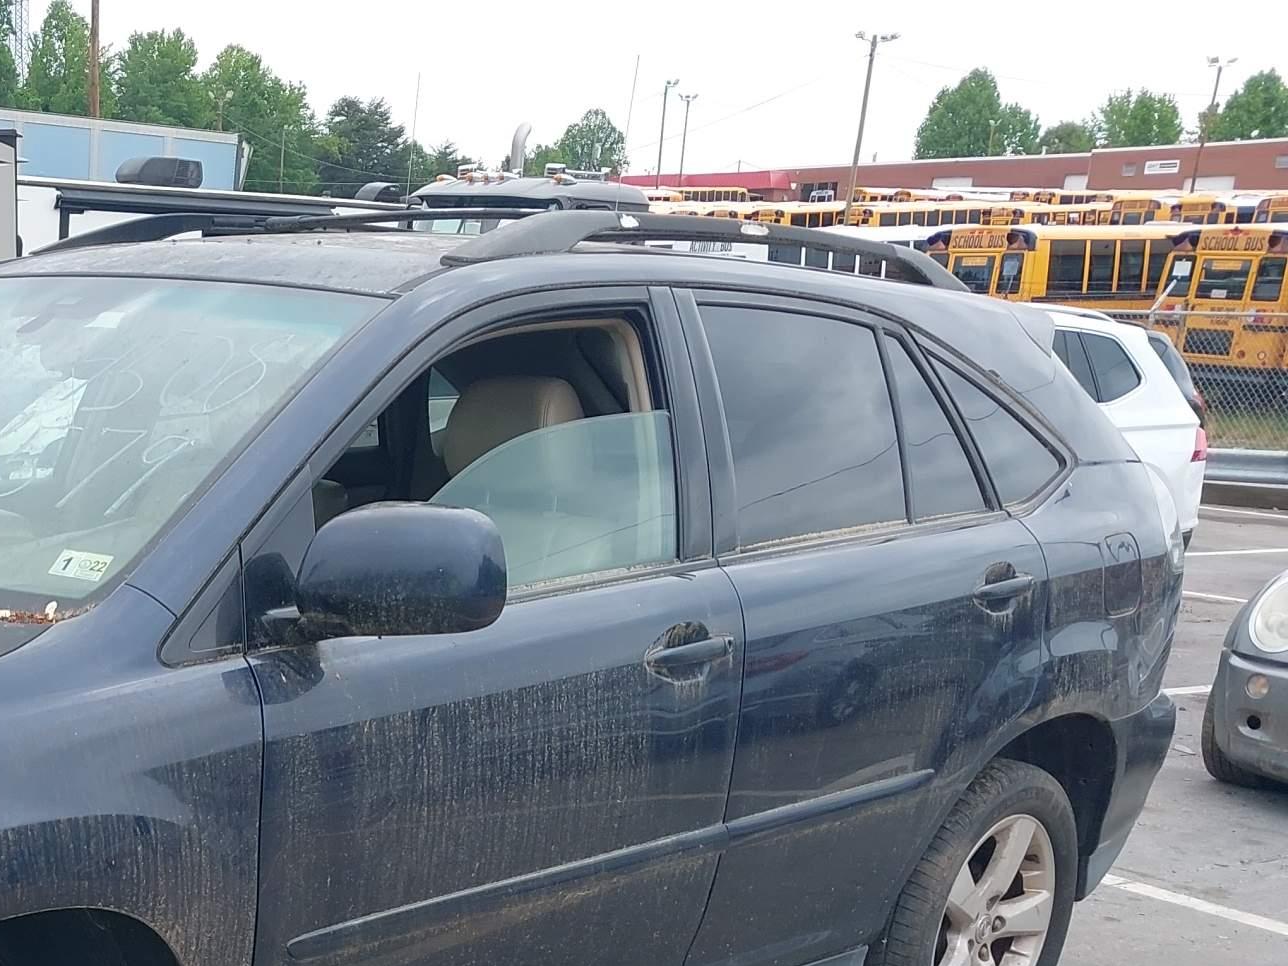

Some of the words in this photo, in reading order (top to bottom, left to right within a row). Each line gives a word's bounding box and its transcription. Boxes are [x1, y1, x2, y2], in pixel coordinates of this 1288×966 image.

[689, 240, 716, 254] ACTIVITY
[719, 241, 733, 252] BUS
[952, 234, 984, 249] SCHOOL
[987, 234, 1006, 249] BUS
[1201, 236, 1240, 251] SCHOOL
[1243, 236, 1267, 251] BUS
[61, 557, 74, 571] 1
[89, 560, 108, 573] 22
